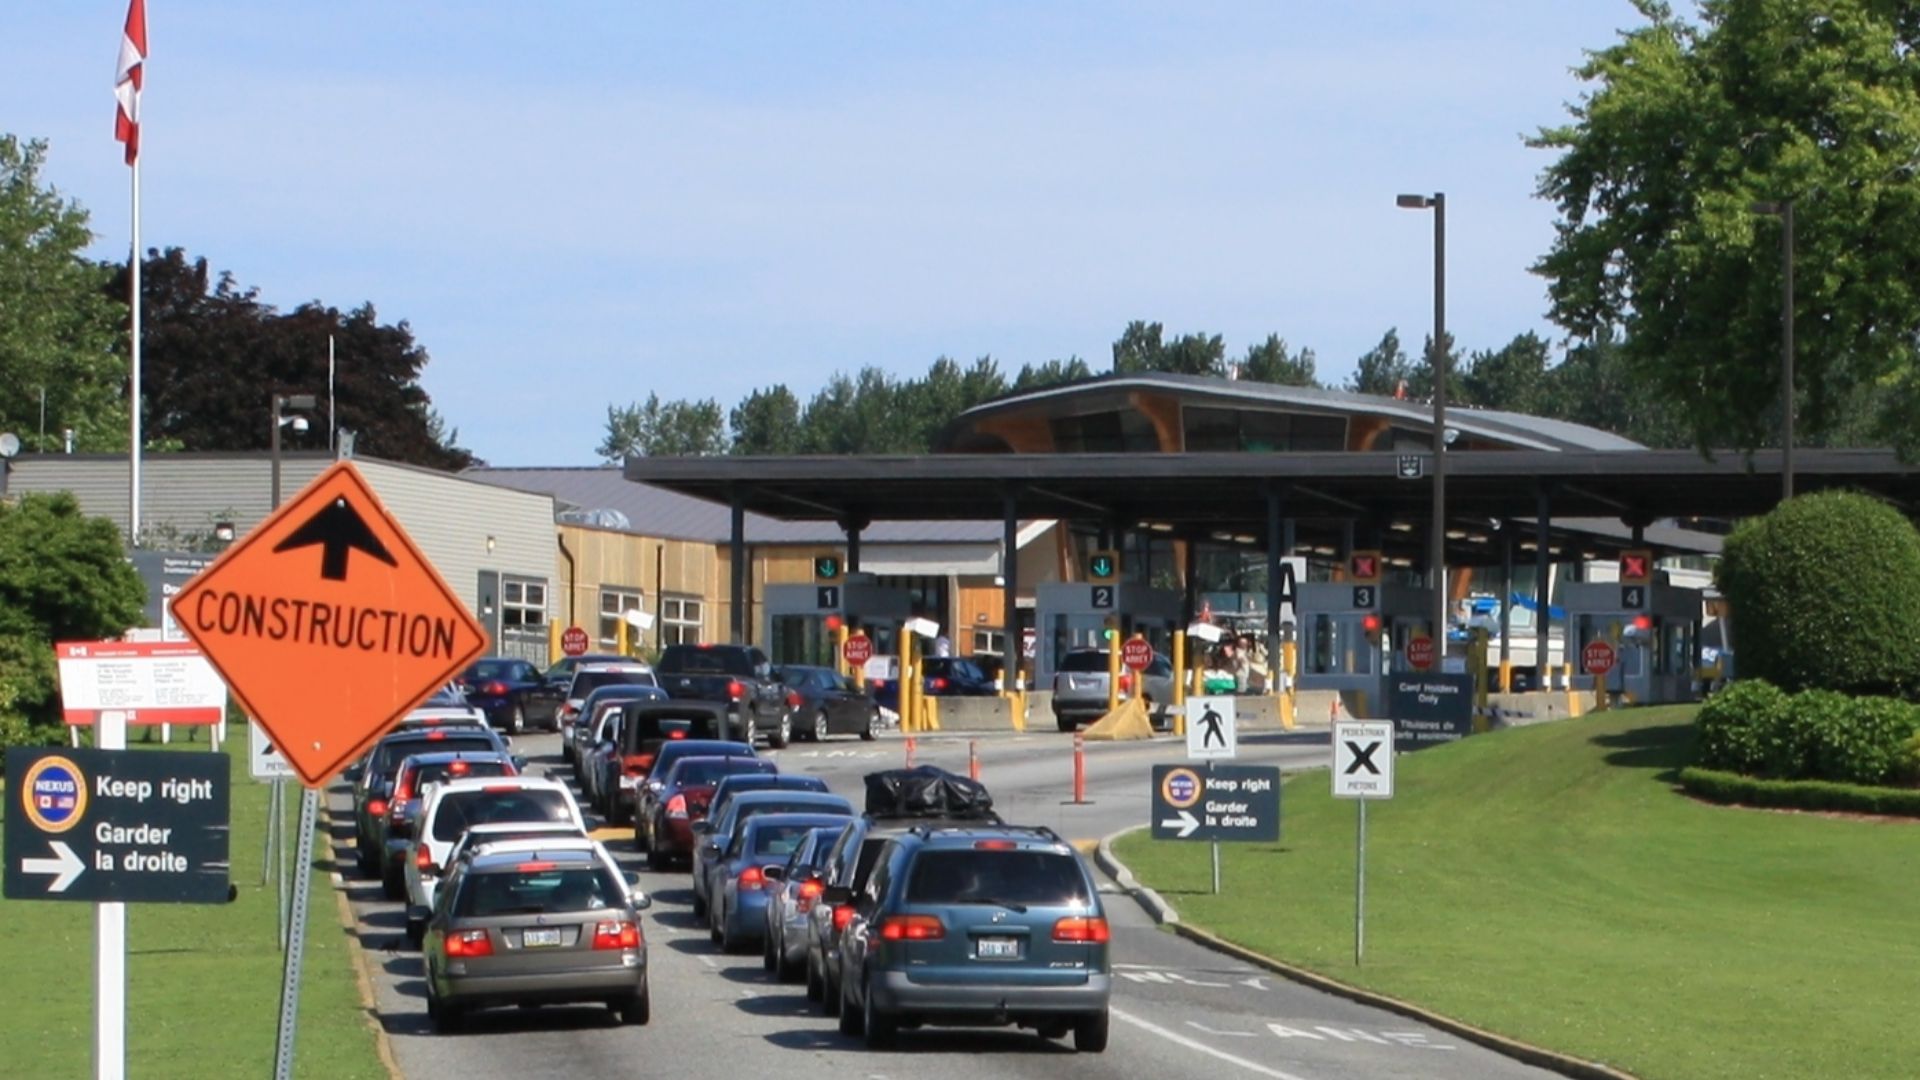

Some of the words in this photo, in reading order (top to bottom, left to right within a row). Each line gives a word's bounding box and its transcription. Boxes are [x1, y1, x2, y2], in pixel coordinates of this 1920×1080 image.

[824, 589, 832, 606] 1
[1096, 588, 1109, 606] 2
[1357, 588, 1370, 606] 3
[1627, 589, 1639, 606] 4
[196, 589, 456, 660] CONSTRUCTION
[564, 633, 585, 641] STOP
[847, 640, 868, 649] STOP
[1126, 645, 1148, 654] STOP
[1587, 648, 1610, 658] STOP
[1399, 682, 1421, 693] Card
[1424, 684, 1459, 694] Holders
[1418, 694, 1439, 705] Only
[1341, 728, 1386, 737] PEDESTRIAN
[35, 780, 75, 793] NEXUS
[96, 776, 152, 802] Keep
[162, 777, 213, 804] right
[1205, 779, 1238, 792] Keep
[1241, 779, 1271, 793] right
[1205, 801, 1248, 813] Garder
[1205, 814, 1217, 826] la
[1221, 815, 1258, 827] droite
[95, 822, 172, 844] Garder
[95, 850, 114, 871] la
[124, 851, 188, 873] droite
